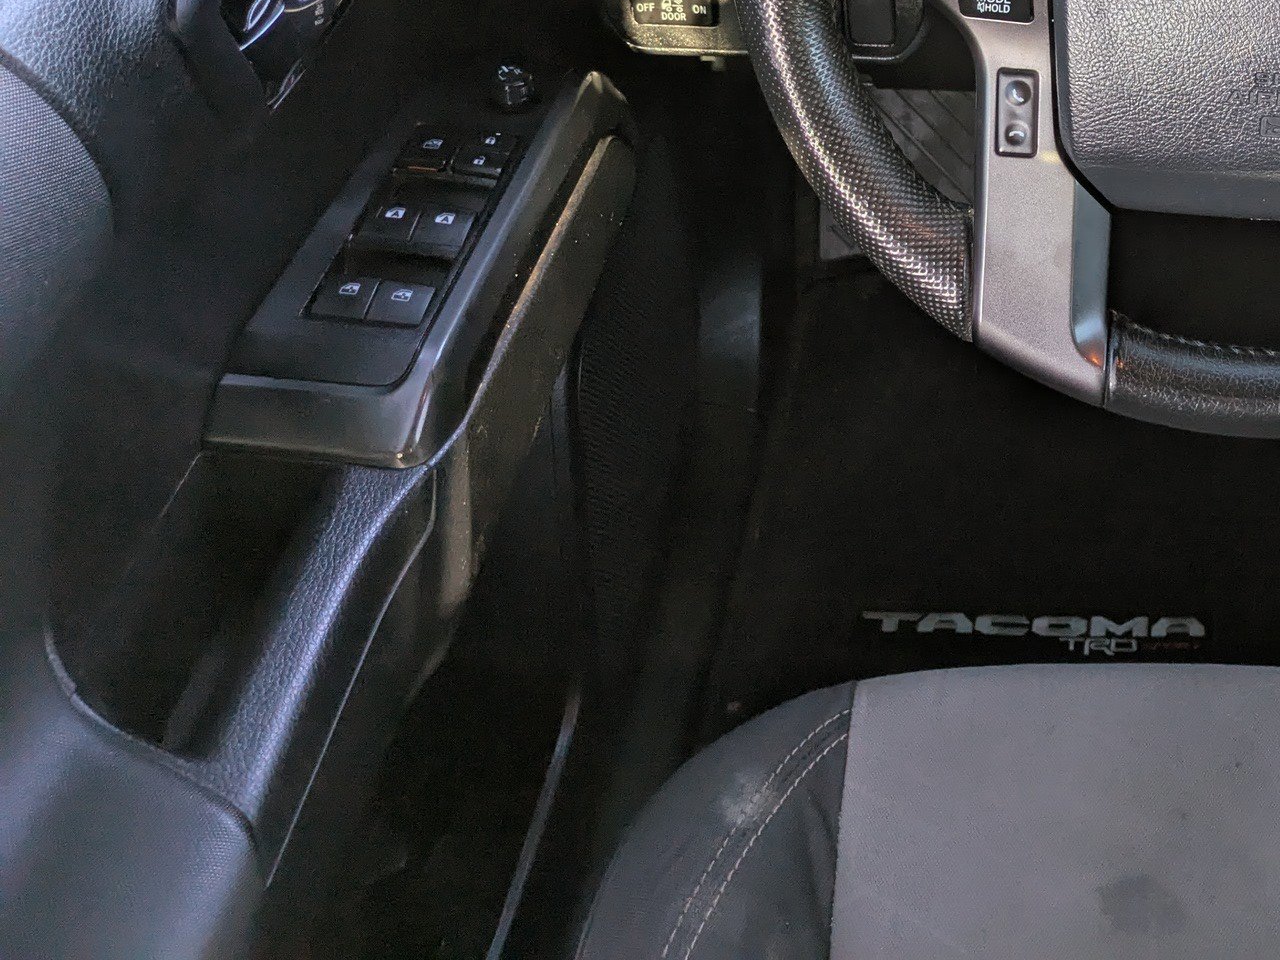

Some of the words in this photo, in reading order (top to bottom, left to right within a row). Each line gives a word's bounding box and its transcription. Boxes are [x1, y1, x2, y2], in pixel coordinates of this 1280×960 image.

[636, 3, 655, 12] OFF
[692, 4, 707, 15] ON
[985, 3, 1011, 14] HOLD
[661, 12, 687, 22] DOOR
[862, 611, 1205, 637] TACOMA
[1059, 637, 1138, 657] TRD
